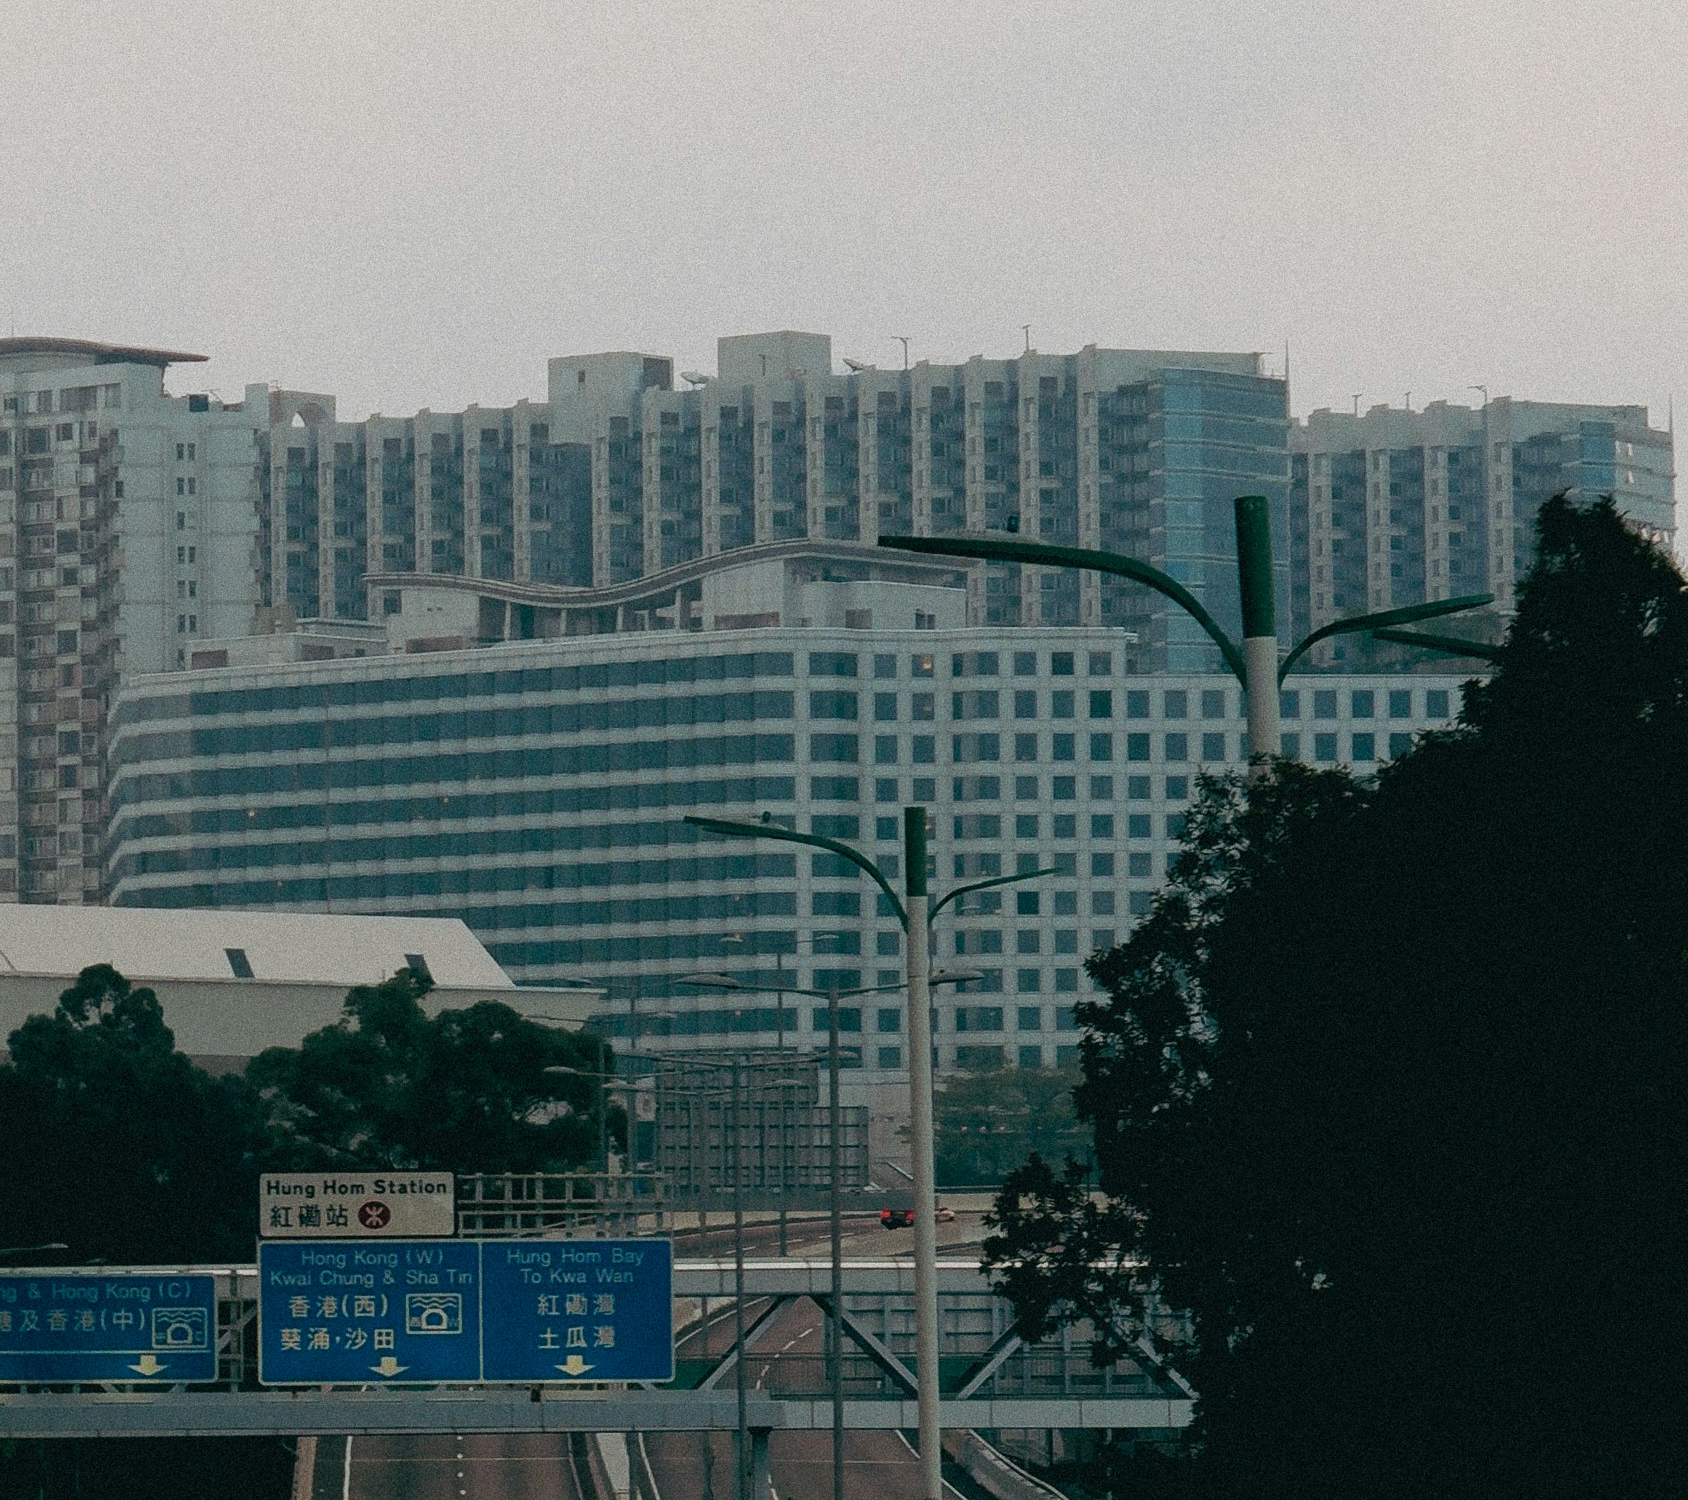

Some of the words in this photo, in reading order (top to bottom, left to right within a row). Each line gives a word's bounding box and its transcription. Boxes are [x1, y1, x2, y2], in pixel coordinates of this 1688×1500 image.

[267, 1180, 315, 1198] Hung
[323, 1180, 365, 1195] Hom
[374, 1179, 447, 1194] Station
[270, 1204, 349, 1227] 紅磡站
[301, 1250, 346, 1269] Hong
[354, 1250, 398, 1268] Kong
[406, 1248, 444, 1265] (W)
[506, 1248, 552, 1267] Hung
[561, 1248, 601, 1263] Hom
[611, 1247, 644, 1267] Bay
[270, 1270, 311, 1286] Kwai
[319, 1270, 374, 1289] Chung
[383, 1269, 395, 1285] &
[405, 1269, 440, 1285] Sha
[446, 1268, 473, 1285] Tin
[519, 1268, 542, 1284] To
[549, 1268, 587, 1283] Kwa
[595, 1268, 634, 1283] Wan
[29, 1282, 41, 1299] &
[52, 1283, 98, 1302] Hong
[105, 1282, 151, 1302] Kong
[159, 1281, 190, 1299] (C)
[289, 1293, 388, 1319] 香港(西)
